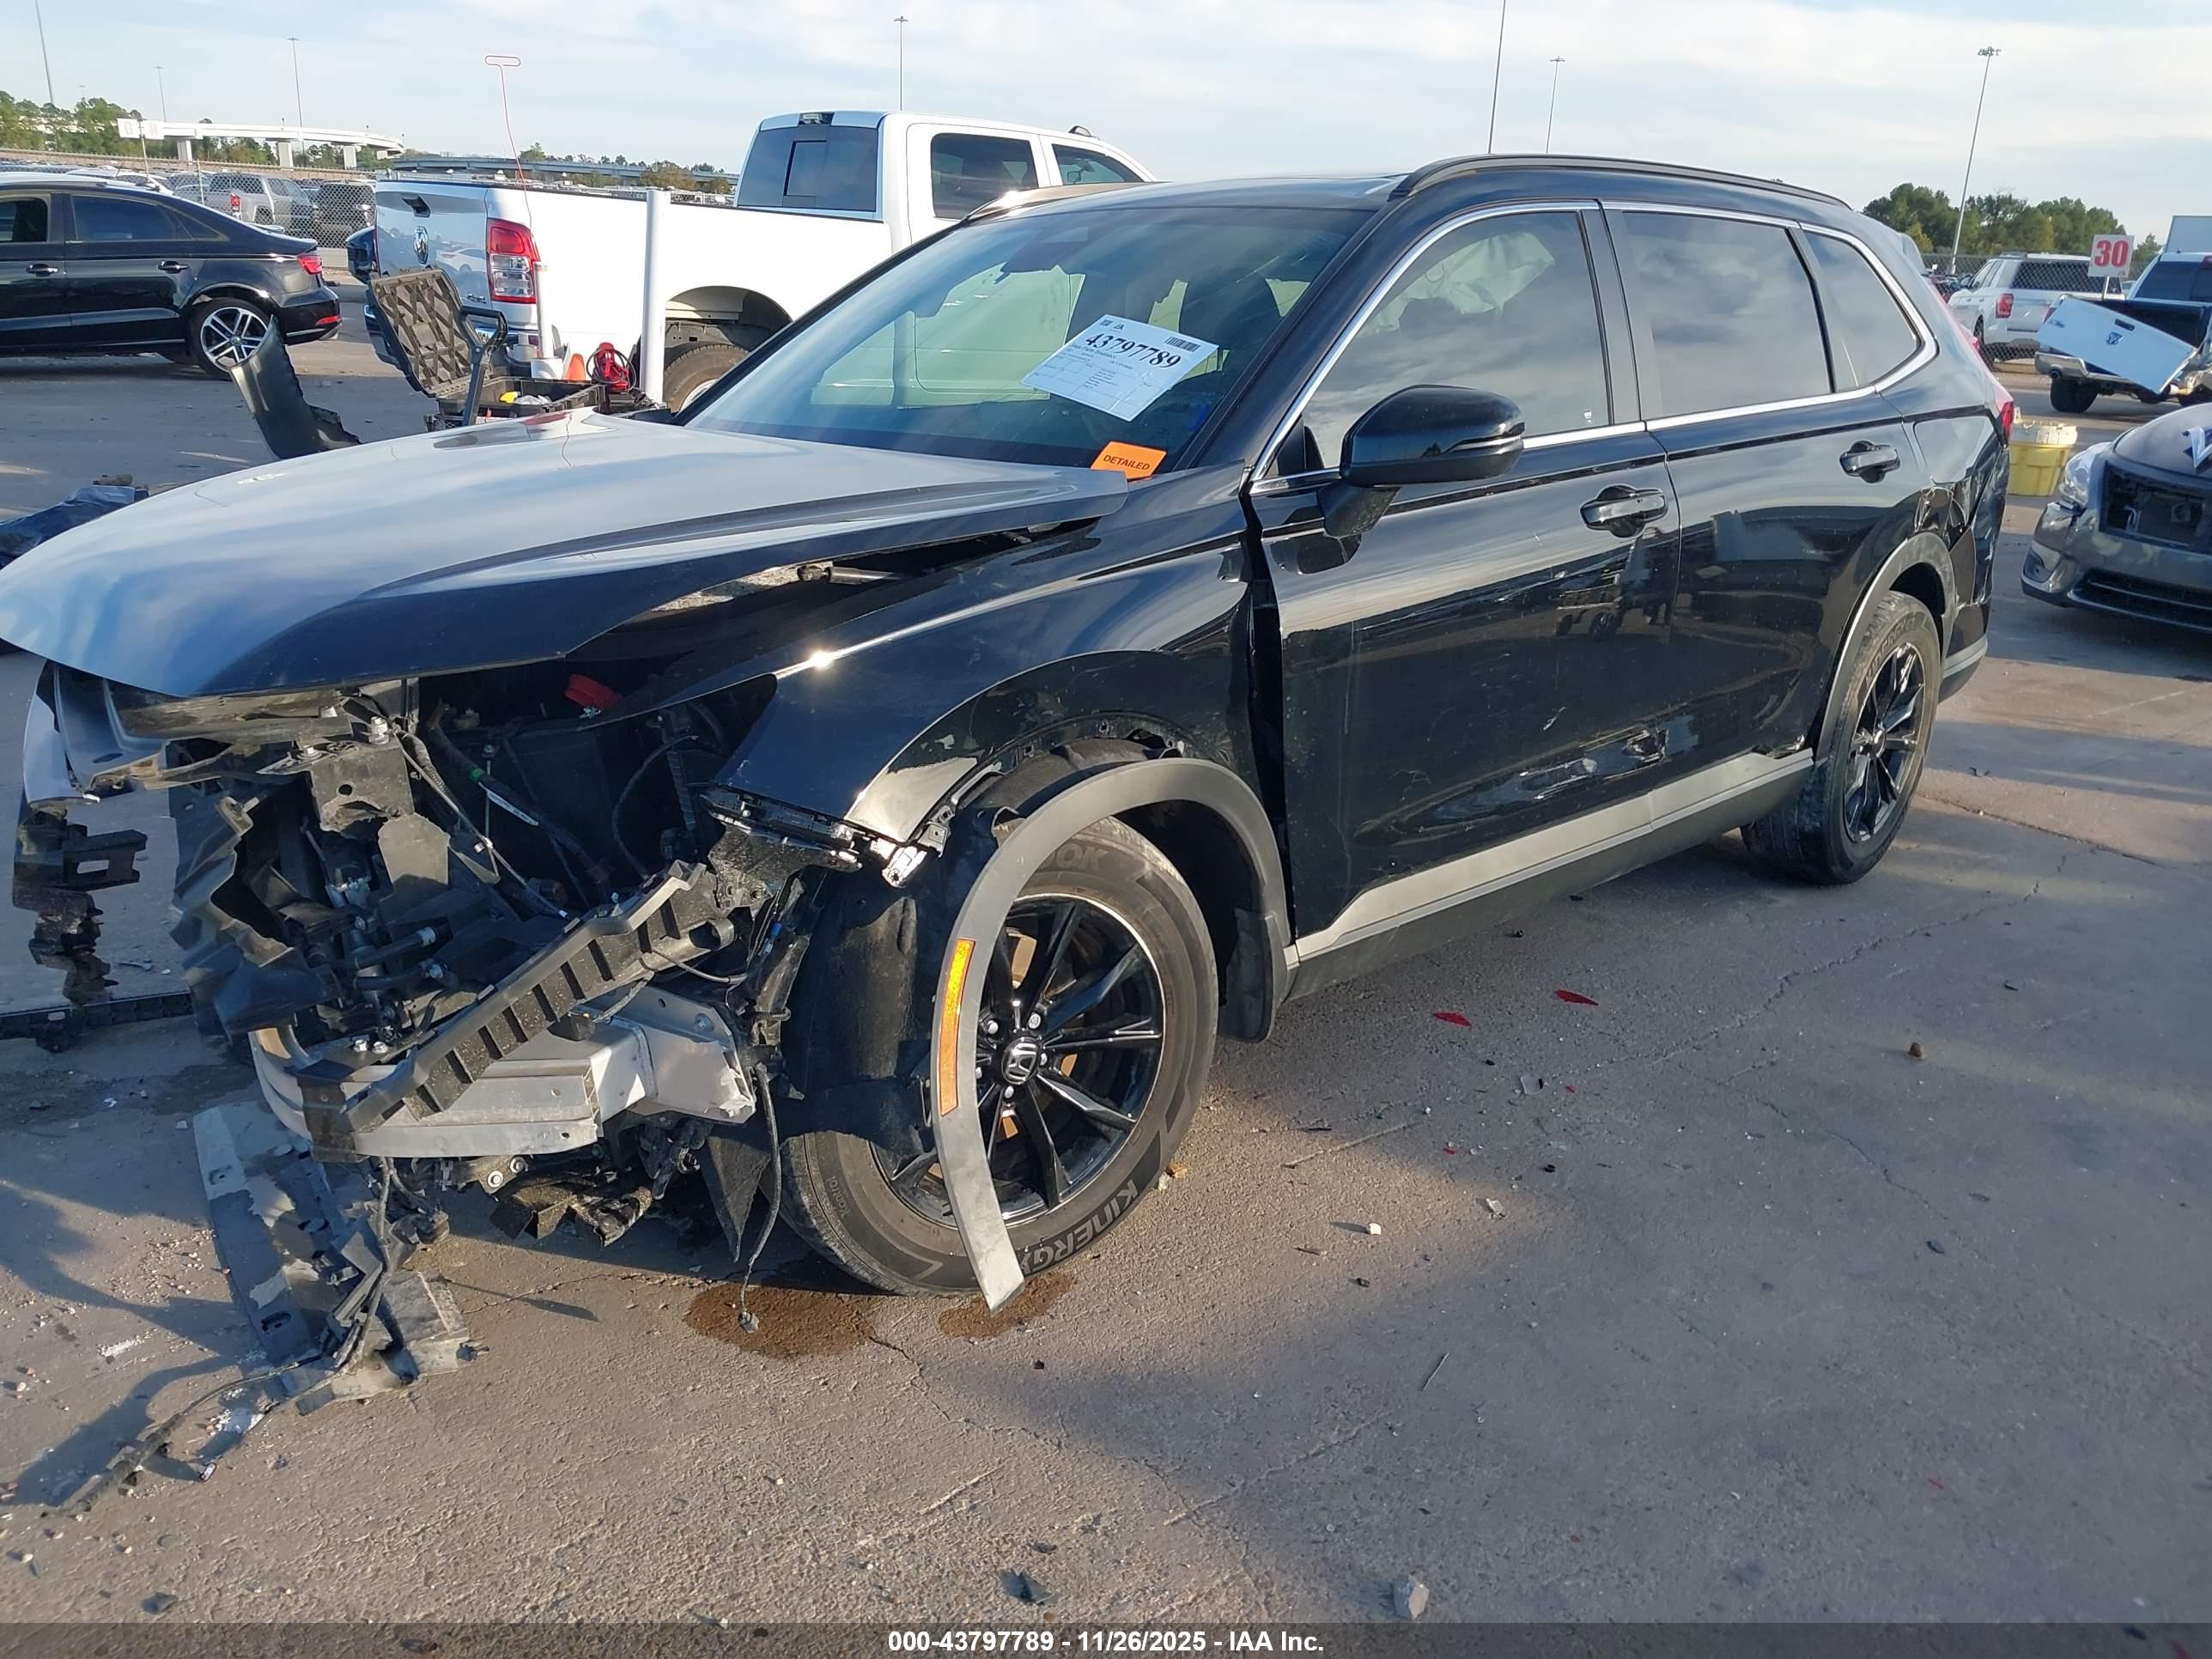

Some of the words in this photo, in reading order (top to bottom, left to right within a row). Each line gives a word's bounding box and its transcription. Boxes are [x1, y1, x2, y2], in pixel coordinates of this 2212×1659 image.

[2094, 240, 2129, 267] 30
[1085, 332, 1182, 368] 43797789
[1103, 454, 1151, 471] DETAILED
